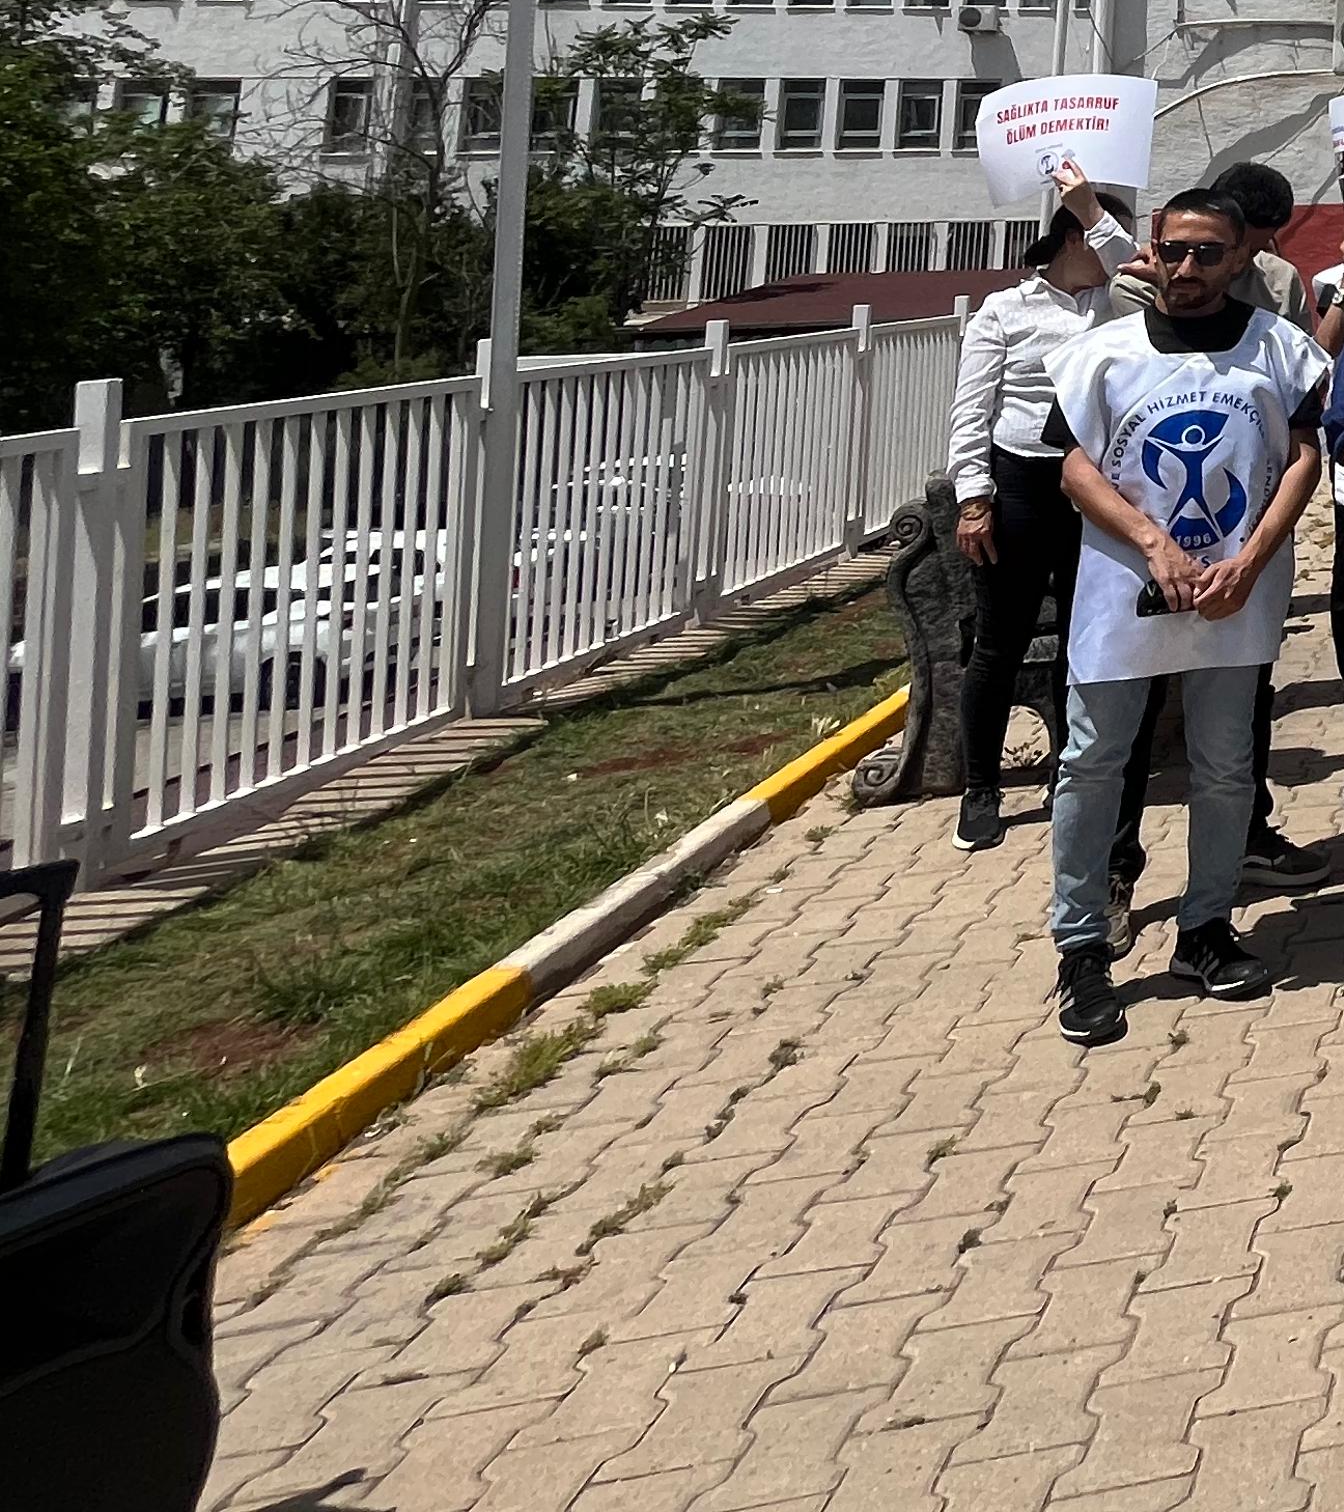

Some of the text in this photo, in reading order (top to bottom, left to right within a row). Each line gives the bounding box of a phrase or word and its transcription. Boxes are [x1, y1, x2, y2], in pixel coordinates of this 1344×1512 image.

[997, 96, 1120, 125] SAĞLIKTA TASARRUF
[1006, 116, 1110, 145] ÖLÜM DEMEKTİR!
[1111, 414, 1146, 467] SOSYAL
[1147, 391, 1207, 415] HİZMET
[1176, 532, 1211, 547] 1996
